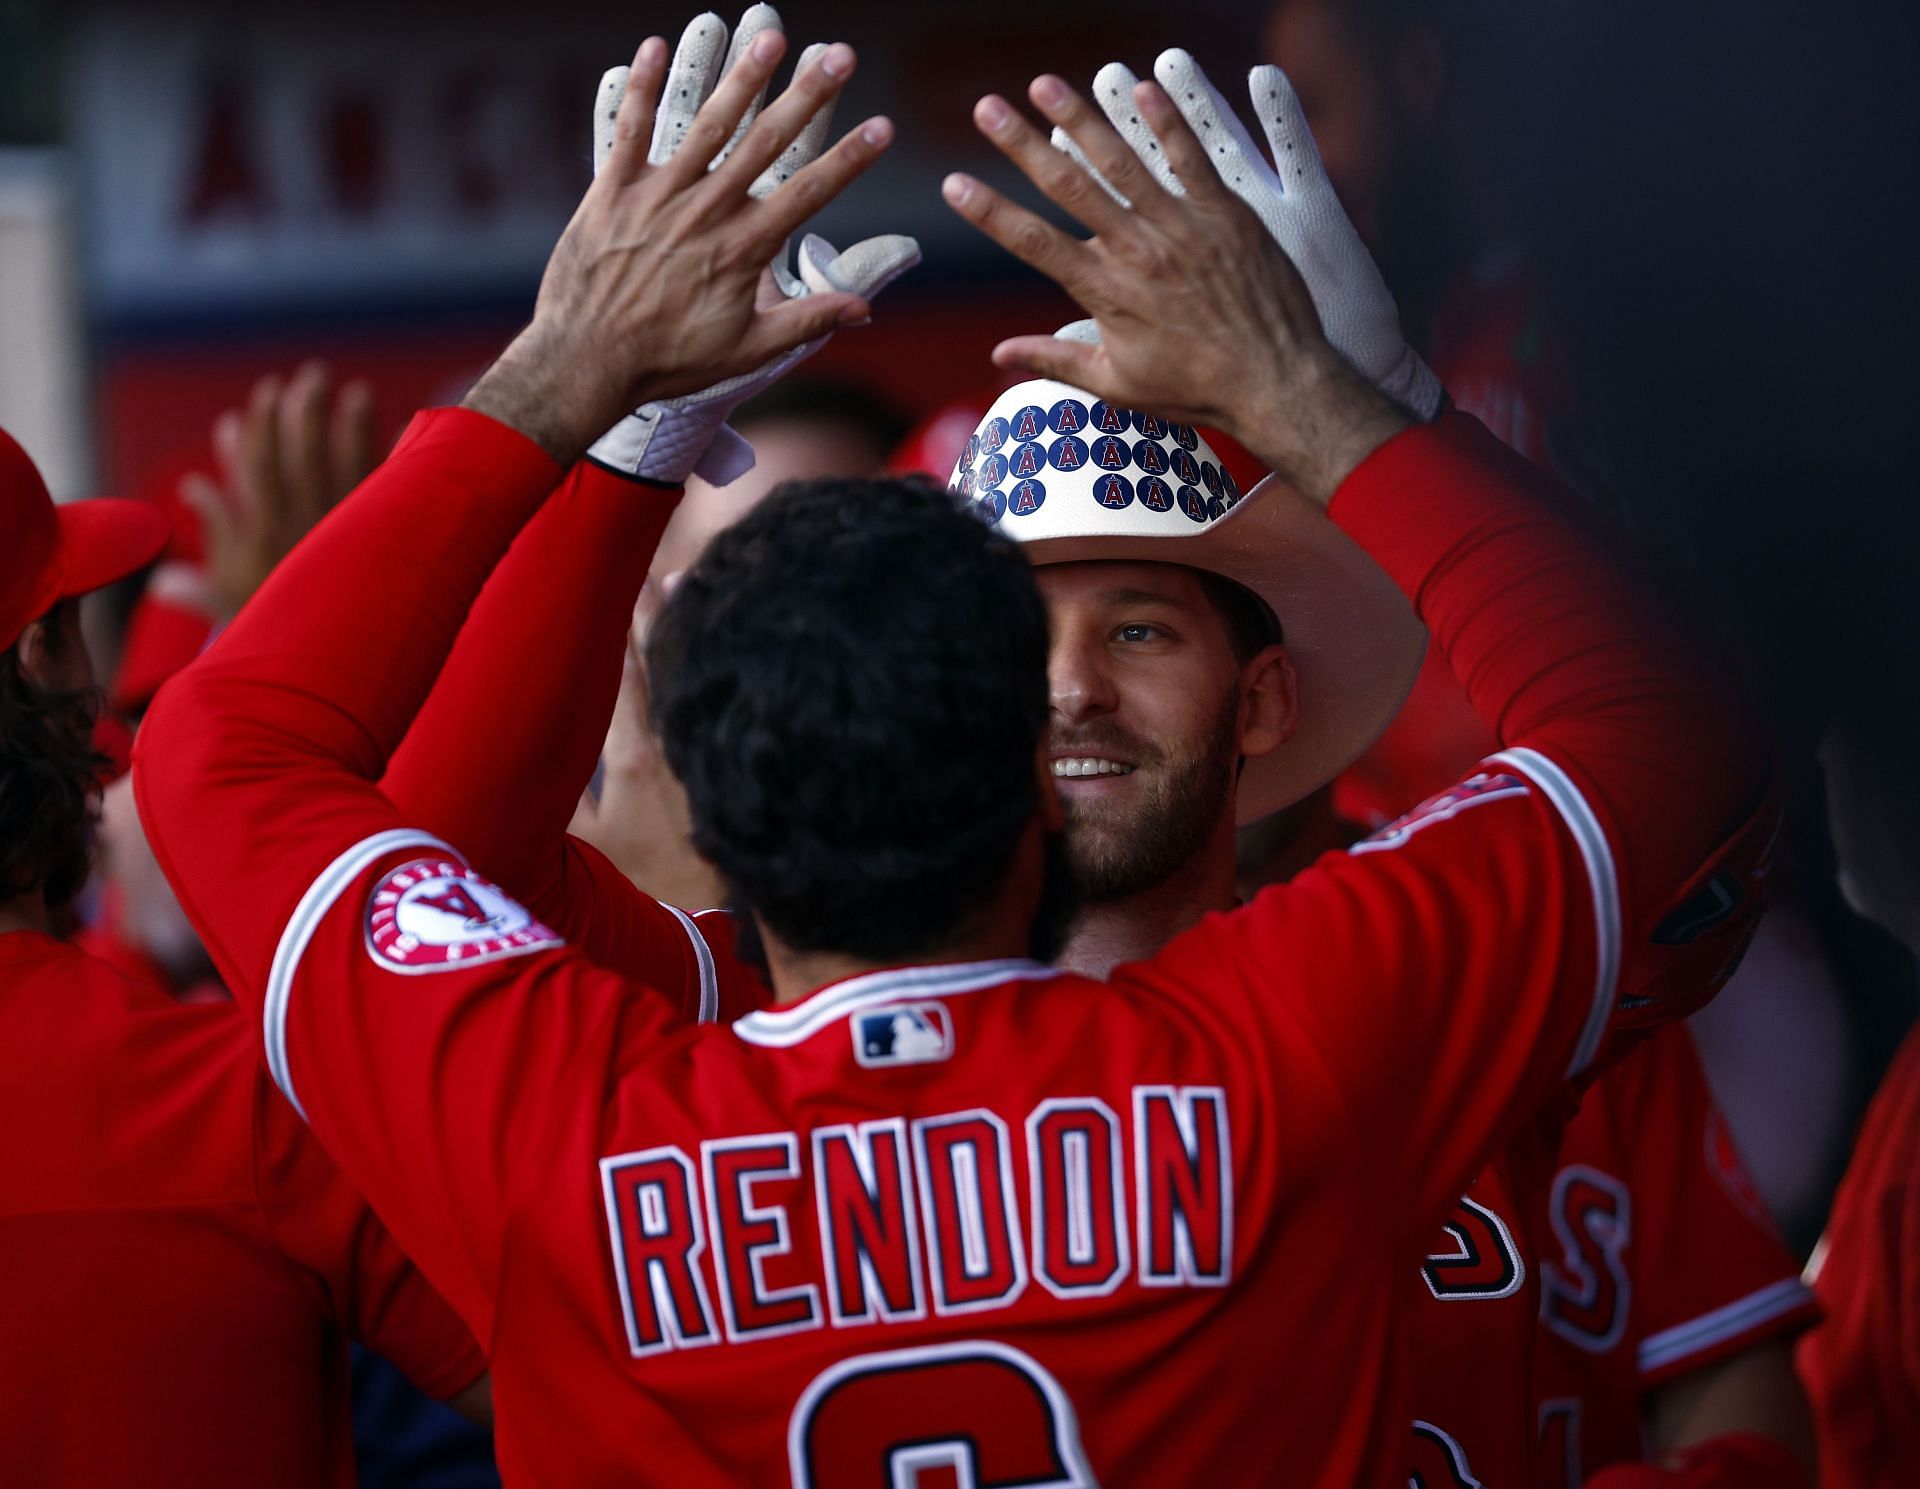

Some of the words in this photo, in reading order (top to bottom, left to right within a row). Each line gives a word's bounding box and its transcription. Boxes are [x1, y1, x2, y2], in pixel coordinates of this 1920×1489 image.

[1016, 406, 1038, 439] A
[1056, 400, 1080, 431] A
[1100, 404, 1123, 431] A
[1016, 442, 1038, 475] A
[1056, 436, 1080, 468] A
[1100, 436, 1124, 467] A
[1143, 440, 1164, 473] A
[1179, 449, 1197, 483] A
[1016, 480, 1038, 513] A
[1103, 474, 1126, 505] A
[1146, 476, 1167, 509] A
[1186, 487, 1204, 520] A
[600, 1085, 1233, 1357] RENDON
